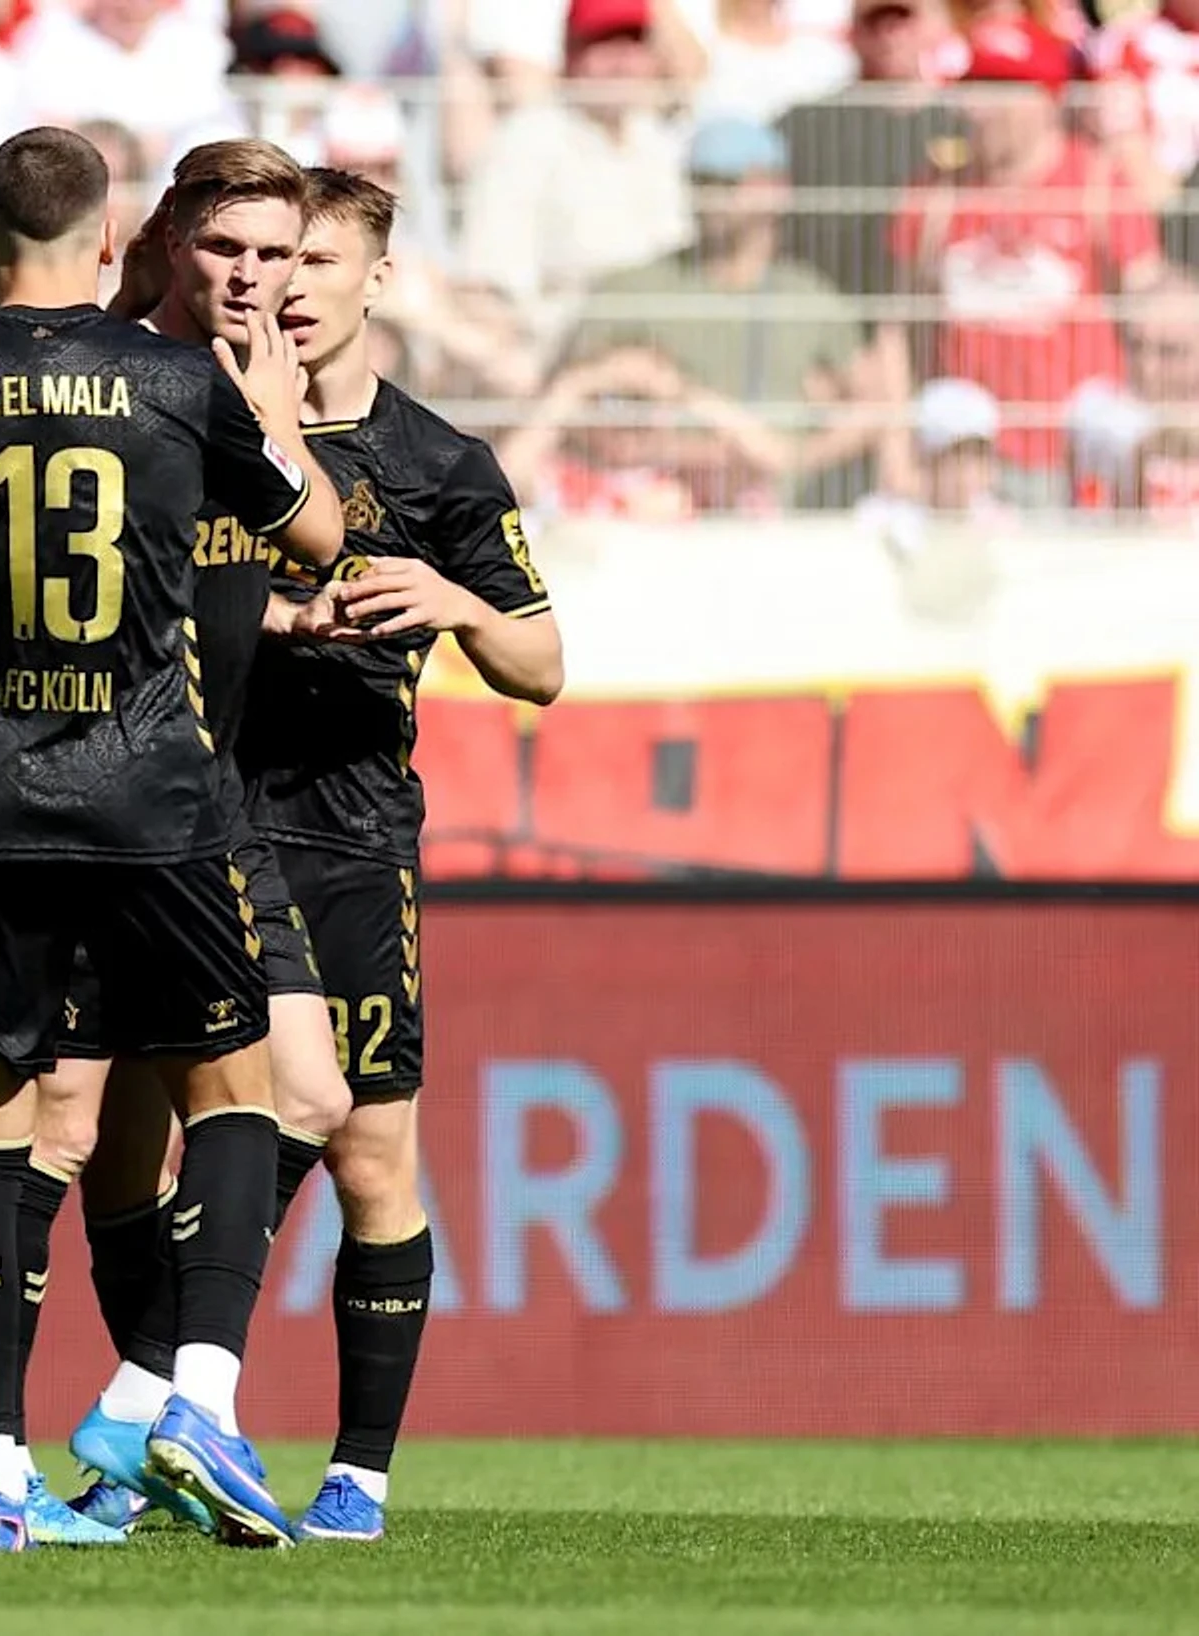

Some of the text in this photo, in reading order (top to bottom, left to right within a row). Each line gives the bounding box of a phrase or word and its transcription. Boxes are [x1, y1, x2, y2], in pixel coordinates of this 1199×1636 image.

[2, 375, 37, 416] EL
[41, 375, 131, 417] MALA
[3, 667, 38, 713] FC
[41, 663, 113, 714] KÖLN
